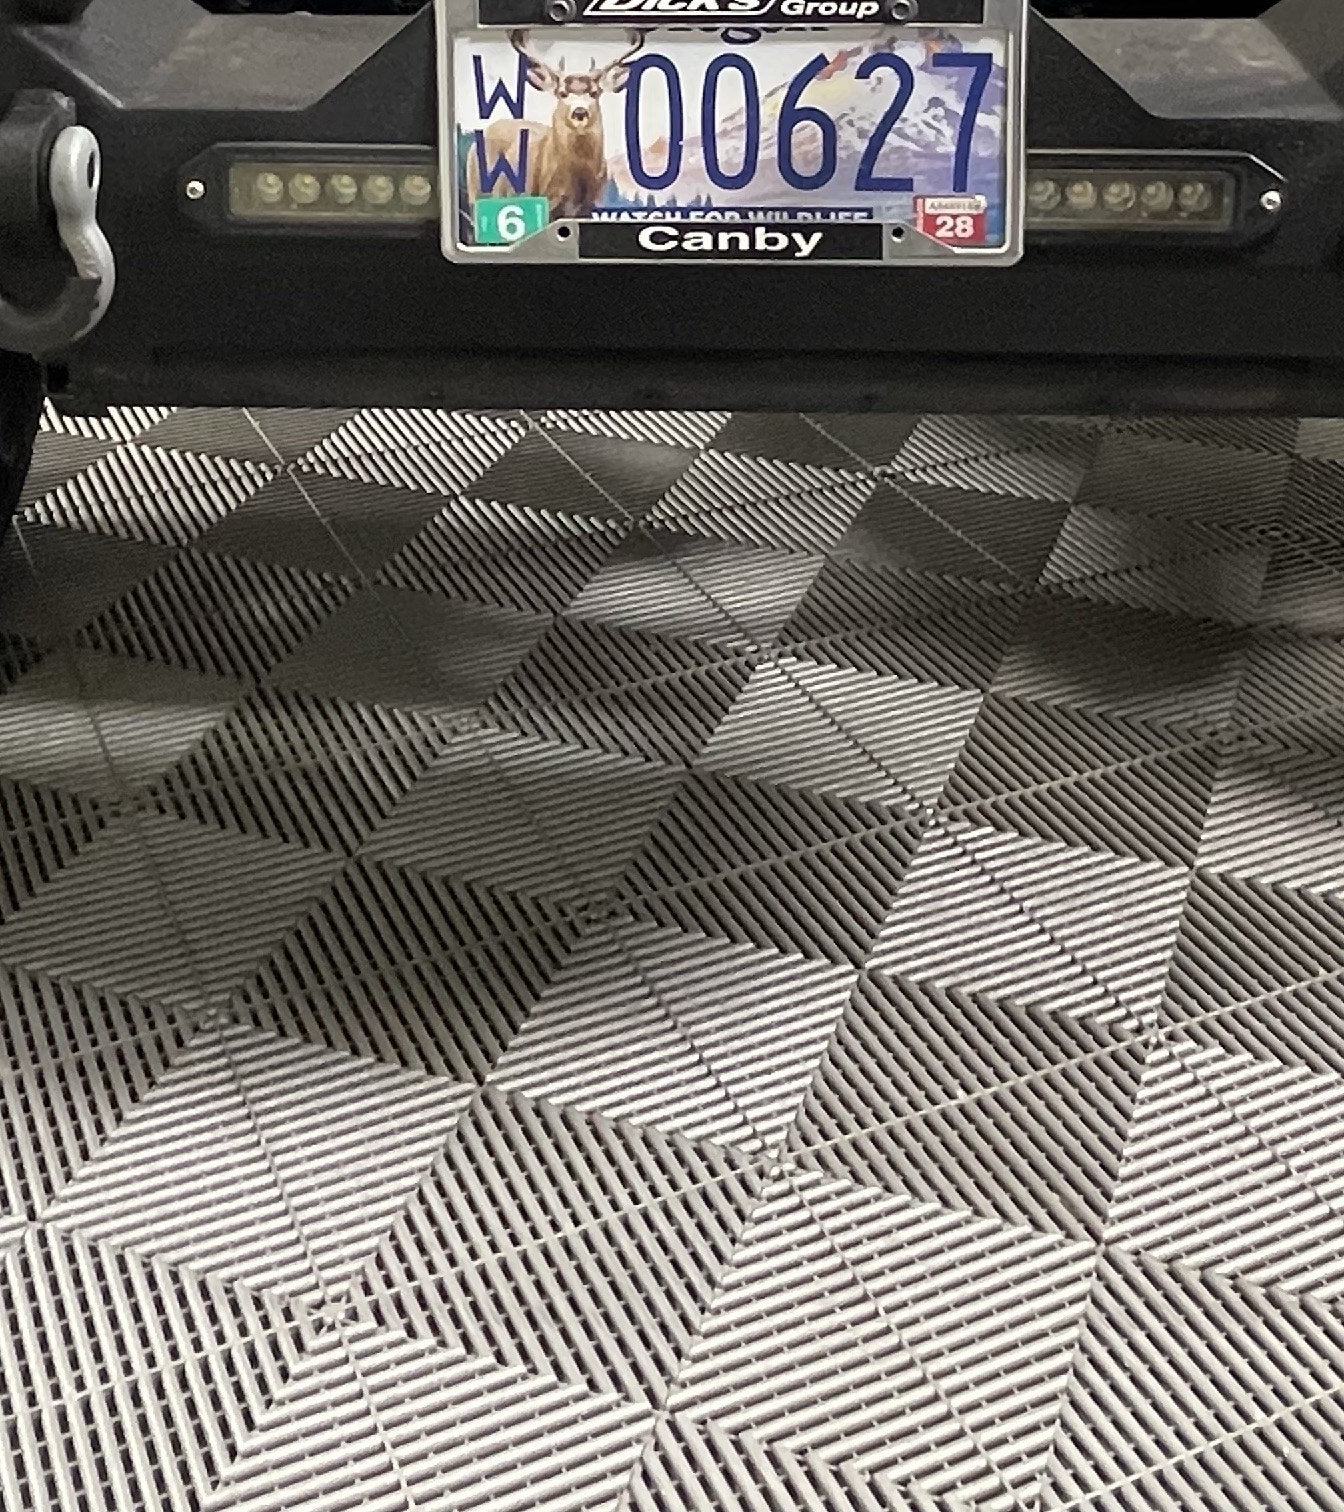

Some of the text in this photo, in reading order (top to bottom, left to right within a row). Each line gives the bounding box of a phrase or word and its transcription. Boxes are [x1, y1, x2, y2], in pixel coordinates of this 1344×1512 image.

[472, 54, 529, 119] W
[624, 52, 993, 192] 00627
[474, 129, 529, 193] W
[497, 205, 526, 241] 6
[637, 225, 823, 257] Canby
[935, 216, 974, 238] 28
